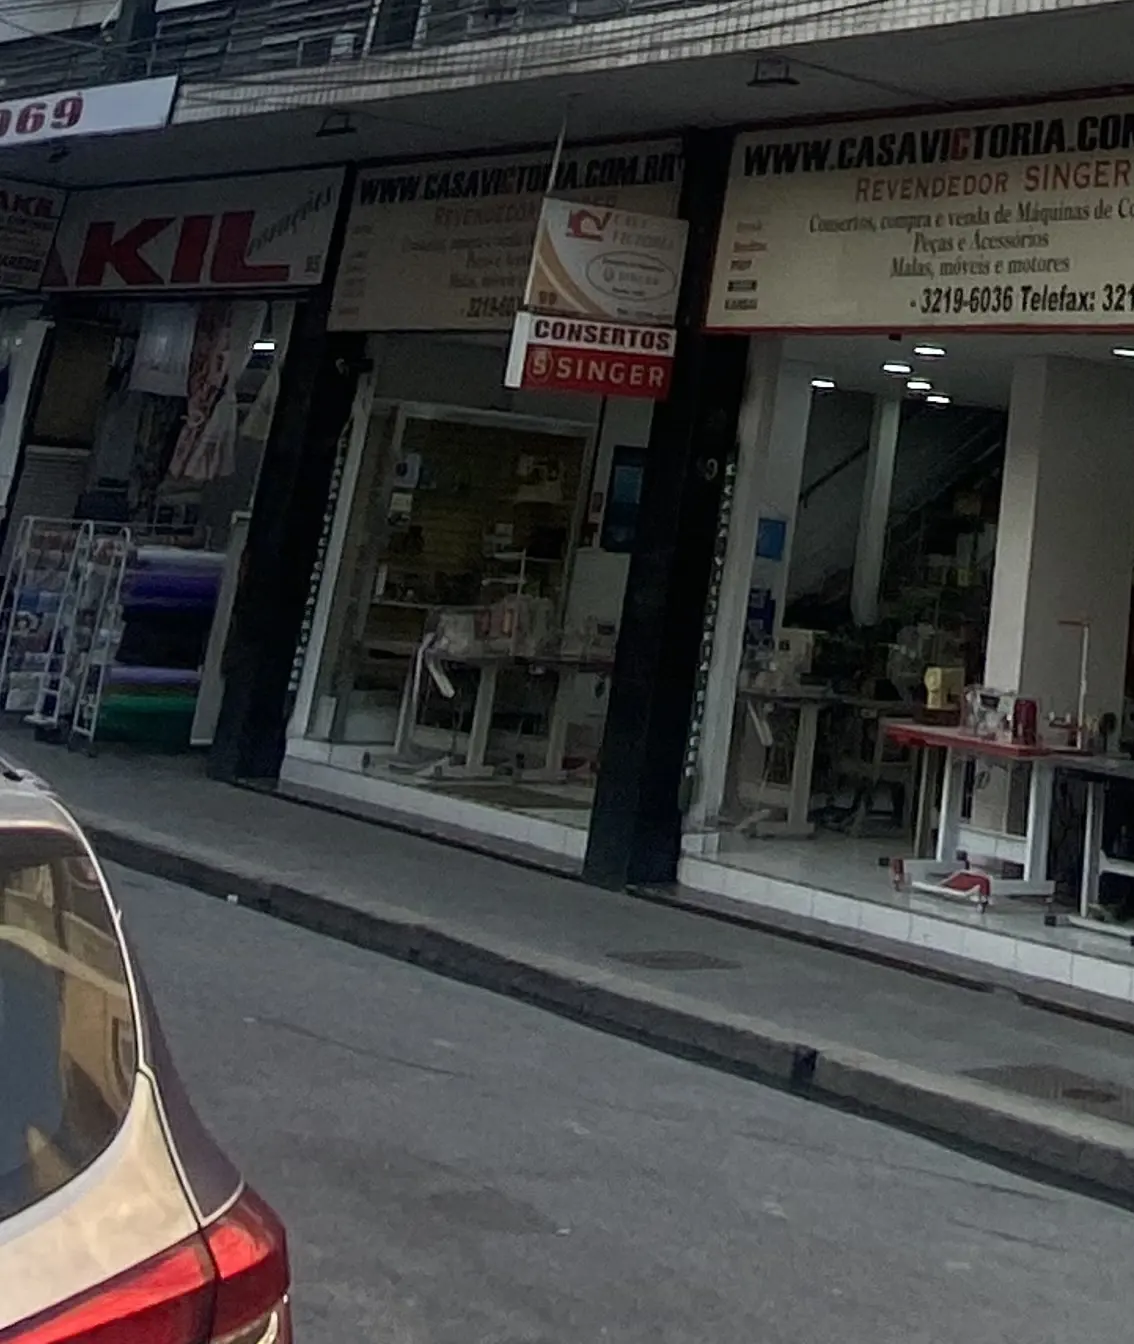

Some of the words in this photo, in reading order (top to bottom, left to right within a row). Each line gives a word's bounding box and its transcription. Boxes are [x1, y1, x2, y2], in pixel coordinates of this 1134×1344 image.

[855, 171, 1010, 203] REVENDEDOR
[1024, 159, 1132, 192] SINGER
[994, 202, 1012, 224] de
[1094, 198, 1112, 219] de
[913, 230, 954, 253] Peças
[958, 236, 966, 250] e
[1008, 255, 1070, 274] motores
[1020, 283, 1096, 313] Telefax:
[534, 318, 673, 351] CONSERTOS
[556, 356, 665, 388] SINGER
